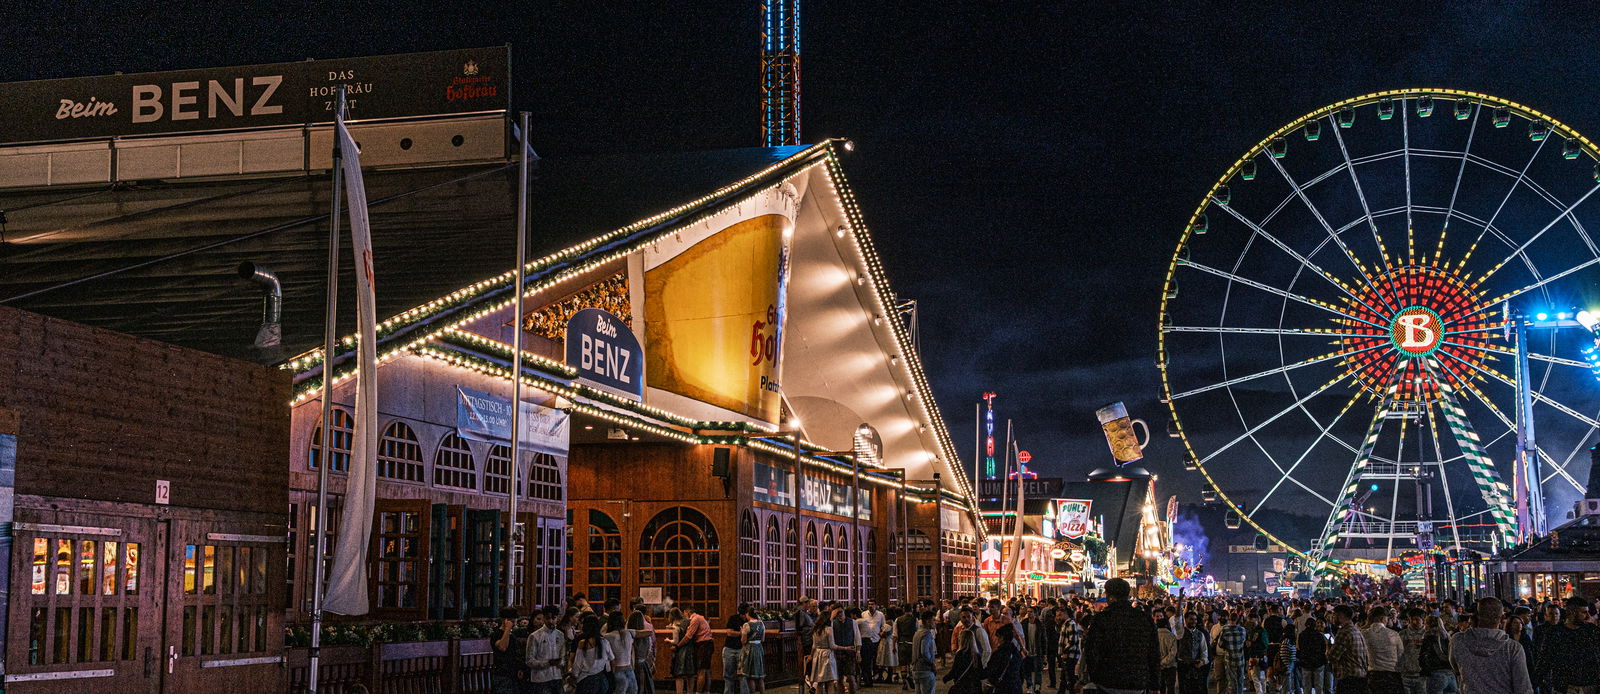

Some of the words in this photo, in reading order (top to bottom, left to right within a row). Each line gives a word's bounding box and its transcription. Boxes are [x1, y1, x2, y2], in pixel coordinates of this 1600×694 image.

[328, 69, 354, 81] DAS
[56, 96, 118, 120] Beim
[132, 75, 283, 124] BENZ
[309, 82, 373, 97] HOFRÄU
[324, 99, 357, 111] ZT
[596, 314, 617, 339] Beim
[1398, 314, 1434, 348] B
[581, 333, 631, 384] BENZ
[157, 485, 168, 499] 12
[804, 479, 832, 508] BENZ
[1062, 522, 1086, 532] PIZZA
